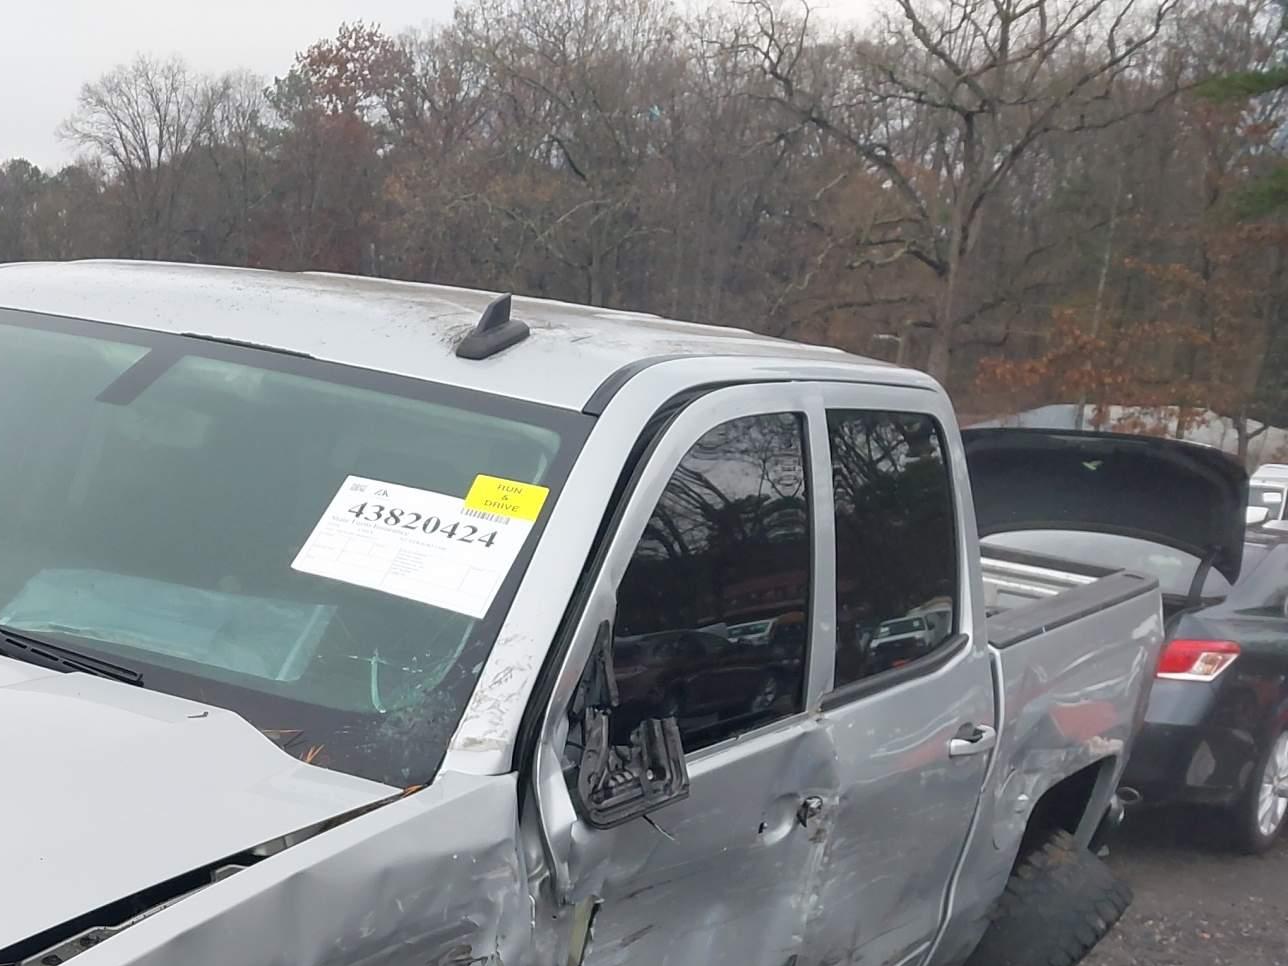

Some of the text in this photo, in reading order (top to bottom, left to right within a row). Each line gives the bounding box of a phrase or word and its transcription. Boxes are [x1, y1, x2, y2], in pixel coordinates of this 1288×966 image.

[497, 484, 523, 495] RUN
[483, 499, 521, 513] DRIVE
[347, 501, 500, 549] 43820424
